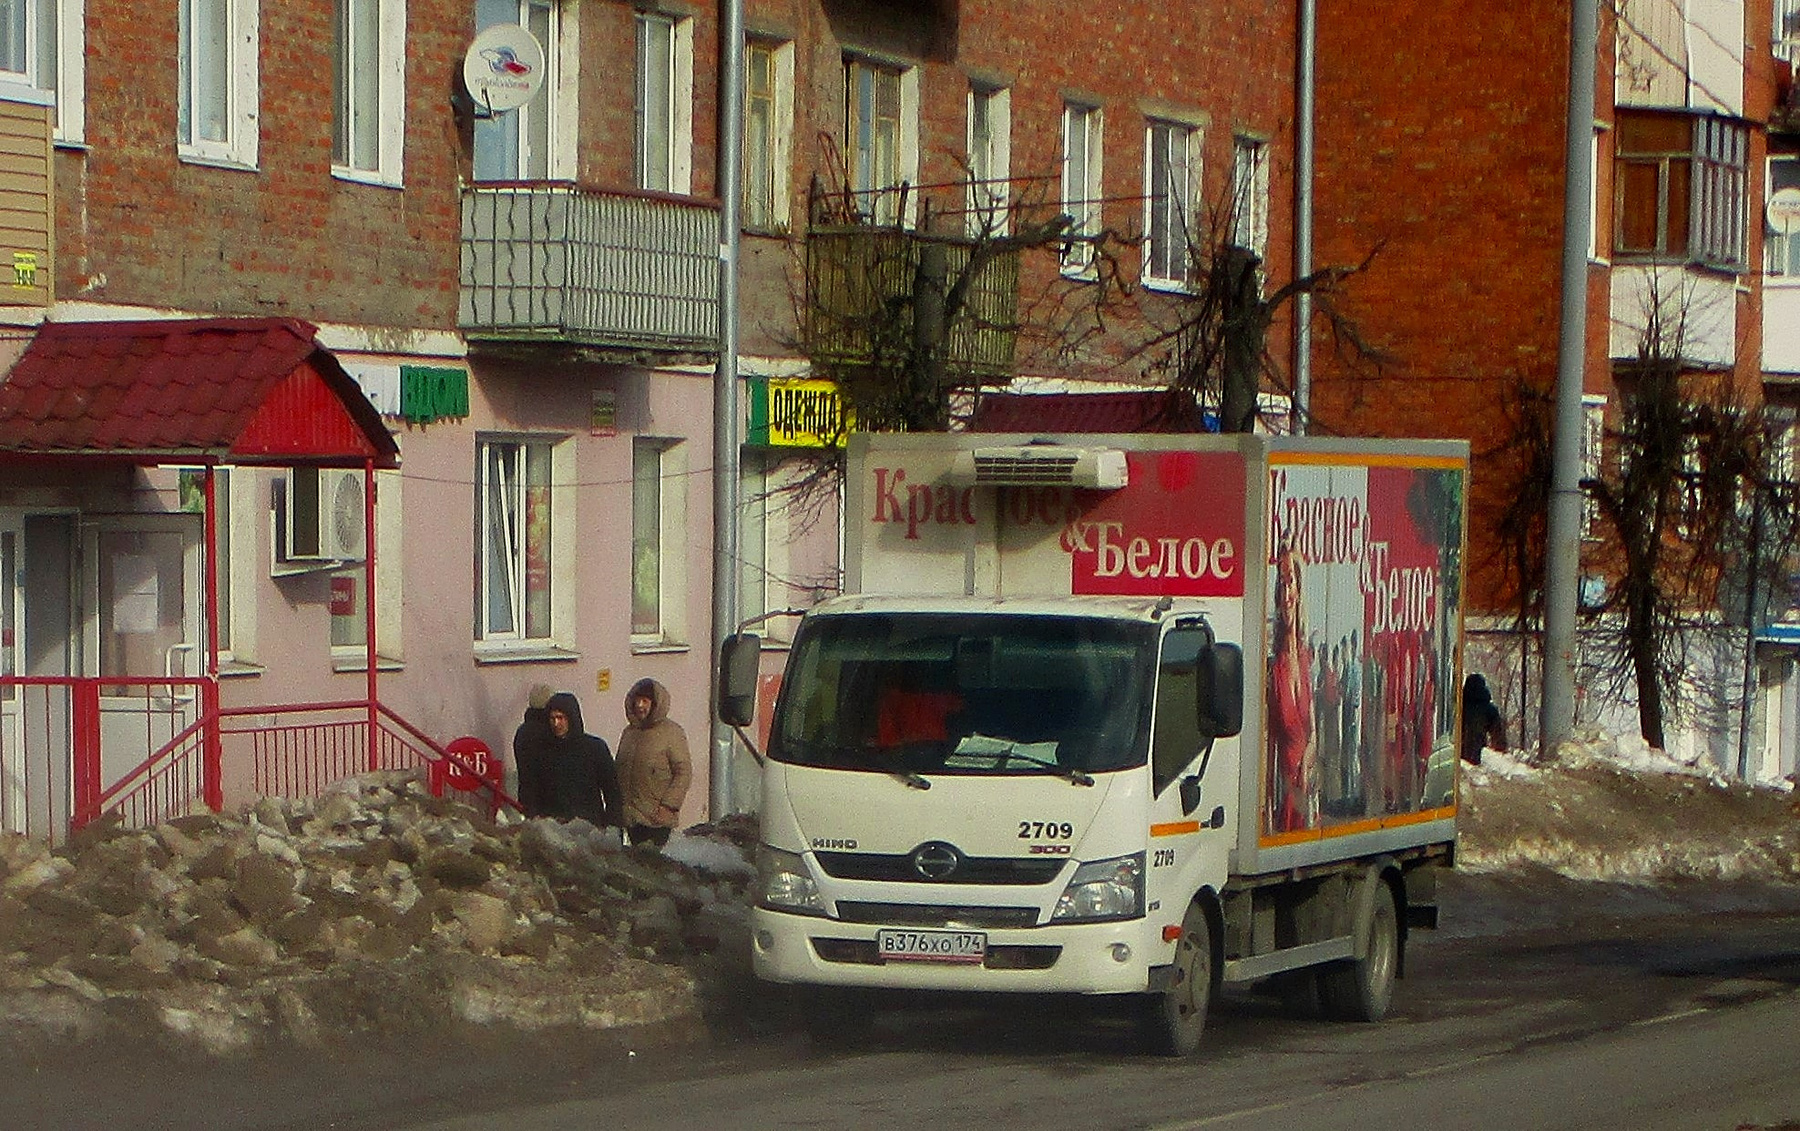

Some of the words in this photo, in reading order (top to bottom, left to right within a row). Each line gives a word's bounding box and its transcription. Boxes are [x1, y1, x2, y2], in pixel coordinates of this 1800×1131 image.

[774, 388, 837, 442] ОДЕЖДА
[871, 467, 1061, 541] Красое
[1083, 521, 1234, 580] Белое
[1370, 541, 1435, 634] Белое
[812, 838, 859, 849] HINO
[1018, 821, 1073, 839] 2709
[1029, 845, 1071, 854] 300
[1153, 849, 1175, 868] 2709
